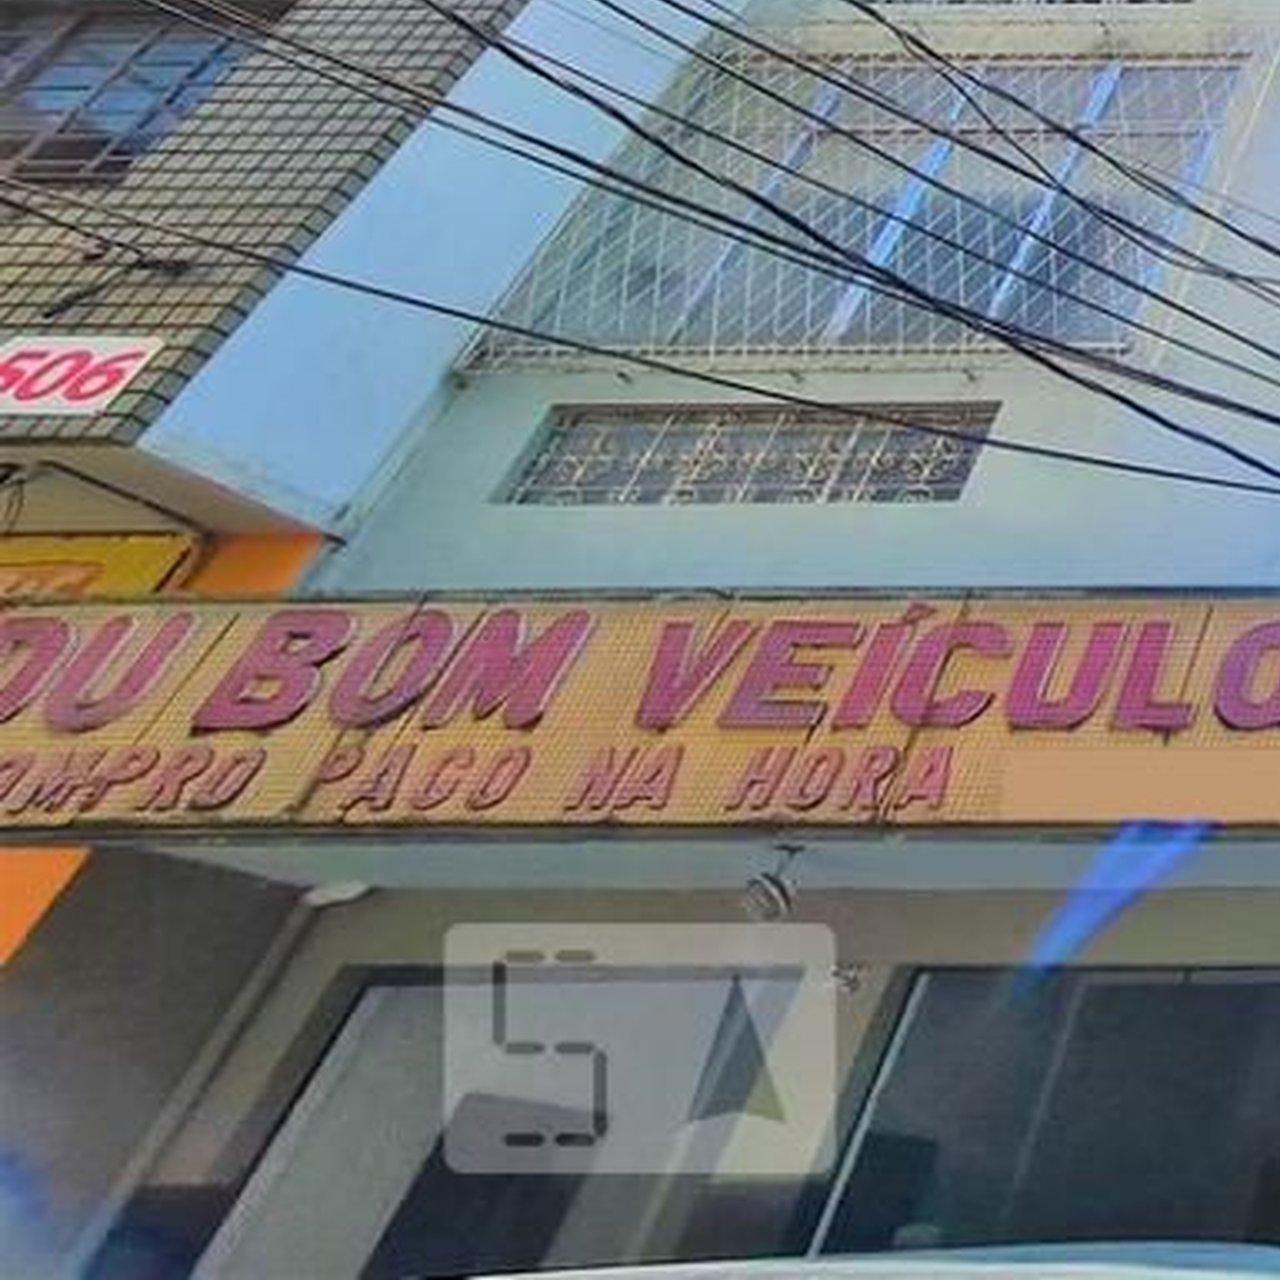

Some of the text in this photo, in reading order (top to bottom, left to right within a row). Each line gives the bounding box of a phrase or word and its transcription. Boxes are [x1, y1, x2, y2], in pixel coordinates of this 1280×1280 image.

[191, 608, 592, 734] BOM
[563, 745, 685, 812] NA
[724, 744, 955, 814] HORA
